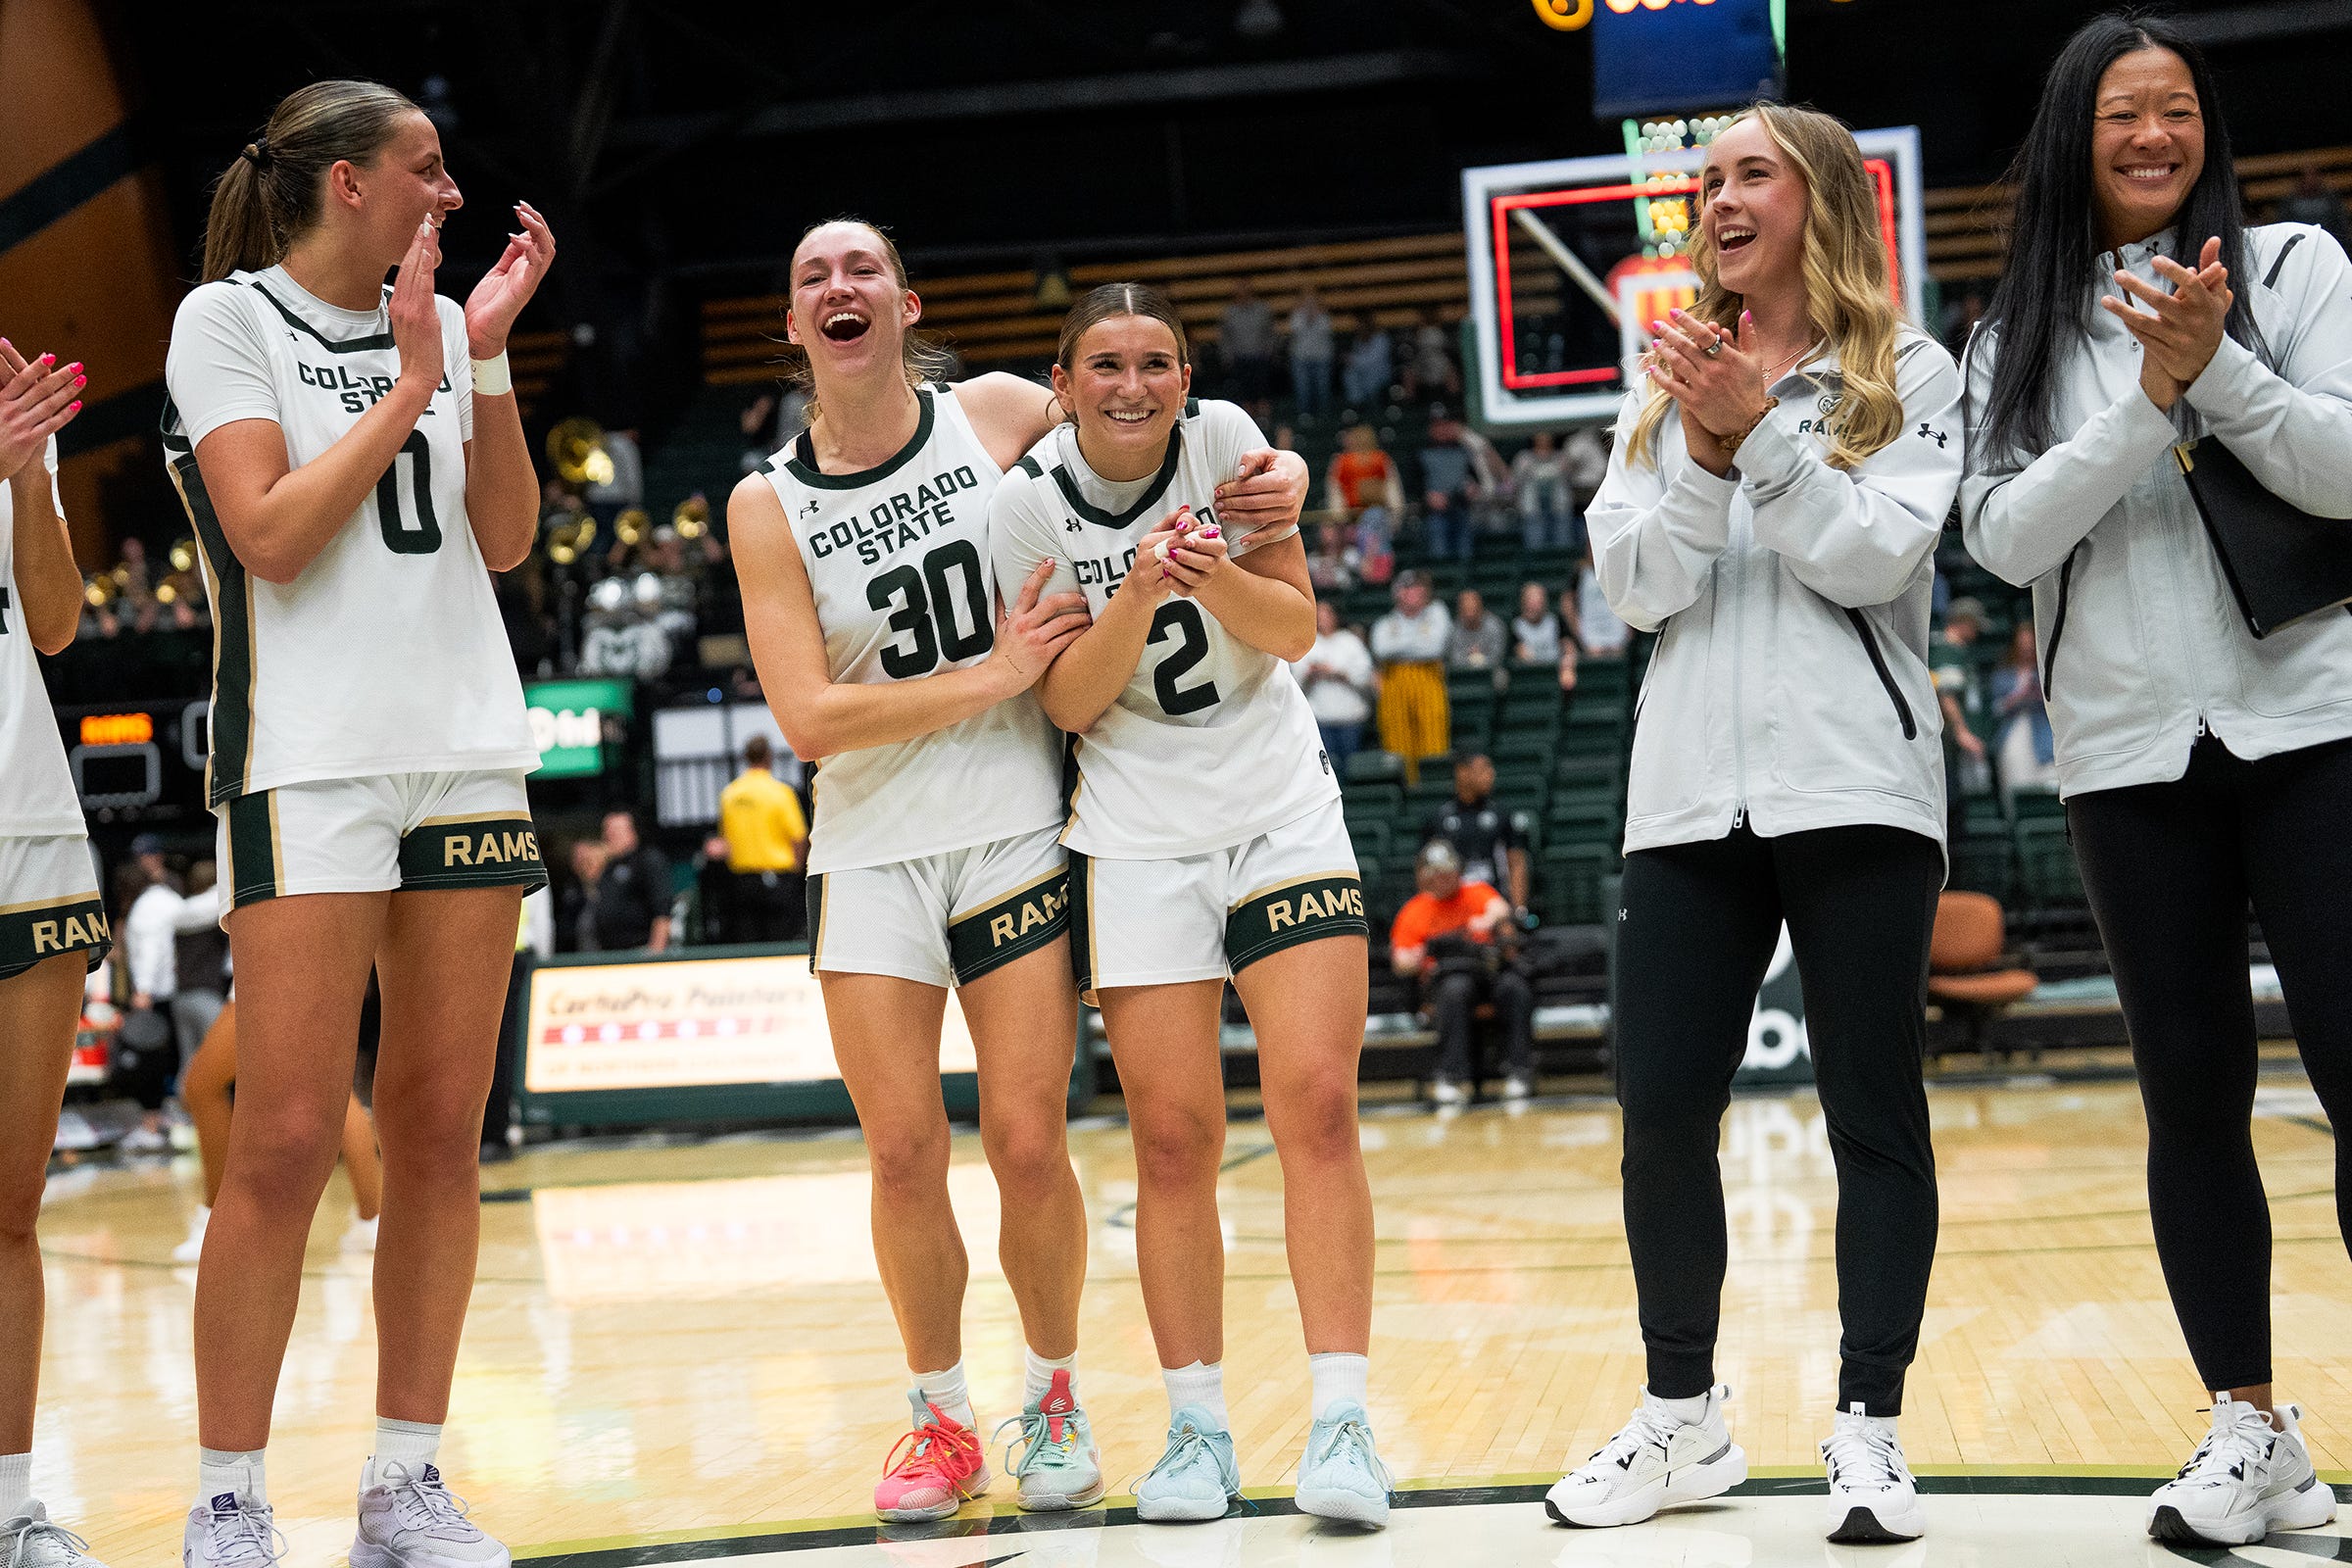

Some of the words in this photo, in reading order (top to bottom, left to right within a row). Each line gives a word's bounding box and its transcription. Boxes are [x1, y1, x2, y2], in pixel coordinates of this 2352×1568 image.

[376, 429, 442, 554] 0
[809, 466, 978, 559] COLORADO
[857, 501, 955, 565] STATE
[866, 539, 994, 679] 30
[1147, 600, 1221, 715] 2
[444, 831, 540, 867] RAMS
[31, 911, 112, 955] RAM
[990, 876, 1070, 948] RAM
[1266, 888, 1365, 932] RAMS
